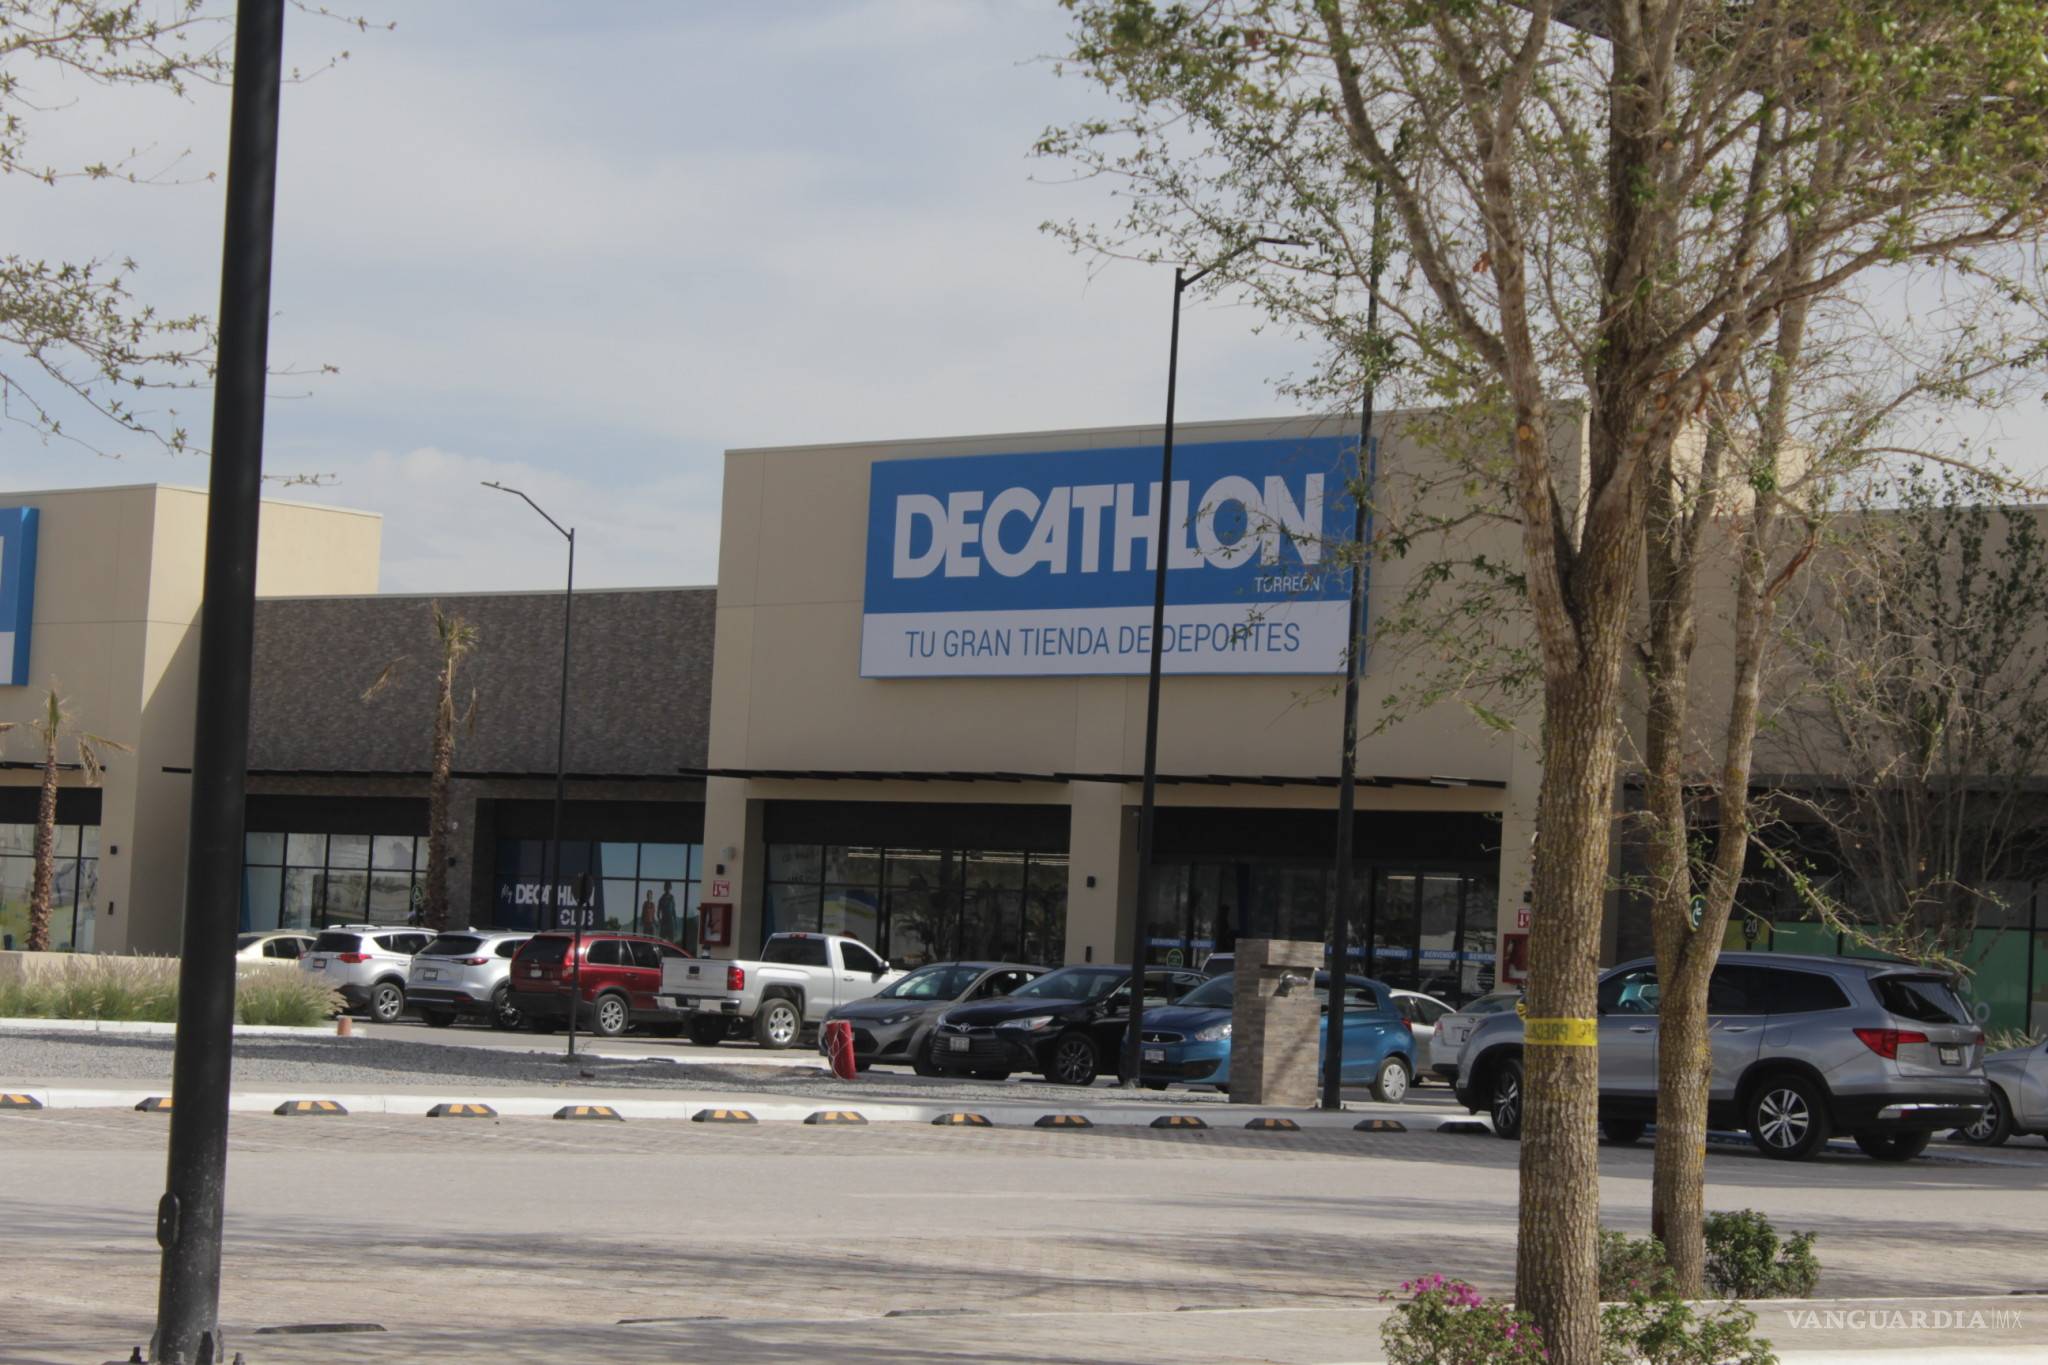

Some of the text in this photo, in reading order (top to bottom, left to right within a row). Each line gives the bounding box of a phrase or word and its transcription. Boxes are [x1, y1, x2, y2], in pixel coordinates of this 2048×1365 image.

[893, 472, 1324, 579] DECATHLON
[905, 622, 1300, 657] TU GRAN TIENDA DE DEPORTES
[515, 883, 595, 906] DECAHL
[1745, 919, 1757, 933] 20
